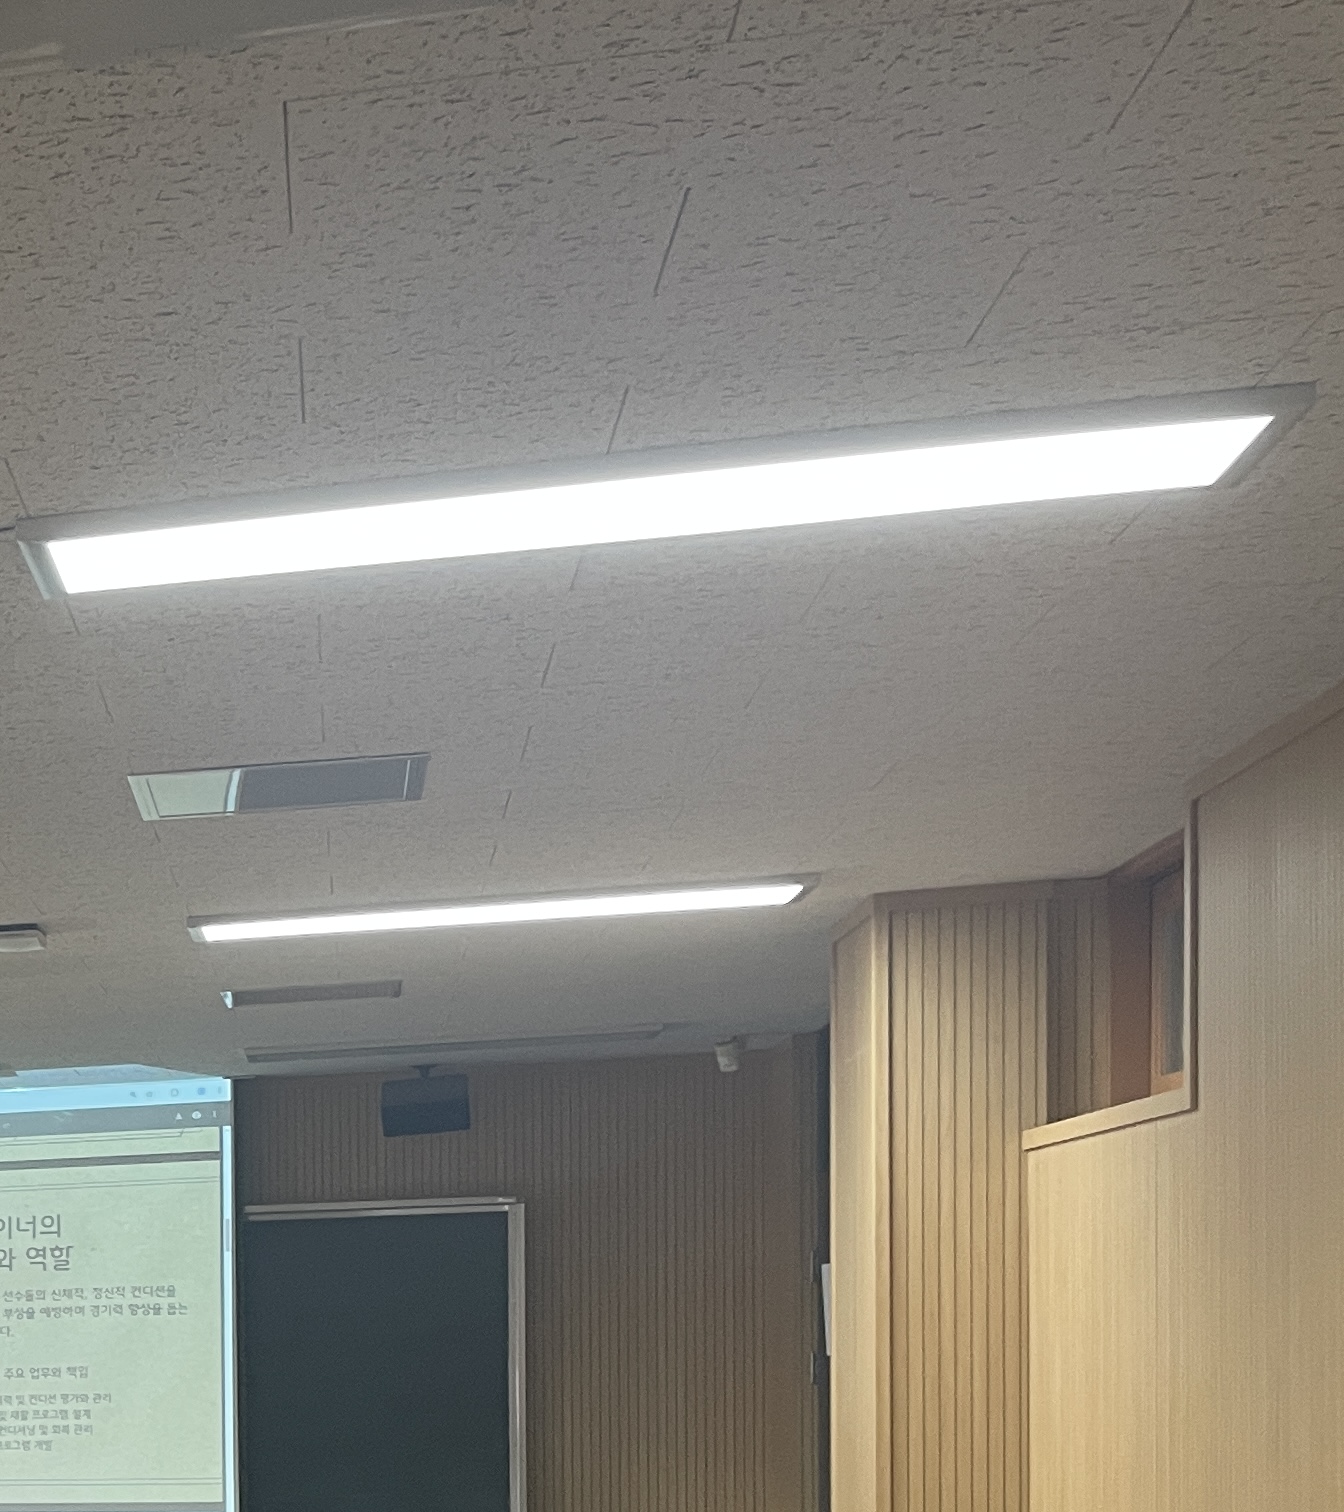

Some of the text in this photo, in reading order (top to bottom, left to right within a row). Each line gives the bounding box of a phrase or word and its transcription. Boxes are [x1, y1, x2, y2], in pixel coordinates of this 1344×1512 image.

[25, 1245, 74, 1272] 역할
[2, 1289, 46, 1302] 선수들의
[92, 1286, 125, 1300] 정신적
[131, 1284, 176, 1298] 컨디션을
[3, 1306, 35, 1320] 부상을
[40, 1305, 85, 1318] 예방하며
[90, 1304, 124, 1317] 경기력
[128, 1303, 163, 1316] 향상을
[167, 1302, 188, 1316] 돕는
[4, 1367, 25, 1380] 주요
[29, 1366, 62, 1379] 업무와
[66, 1365, 89, 1379] 책임
[28, 1394, 56, 1405] 컨디션
[60, 1393, 89, 1405] 평가와
[93, 1392, 112, 1404] 관리
[32, 1409, 69, 1420] 프로그램
[74, 1423, 93, 1435] 관리
